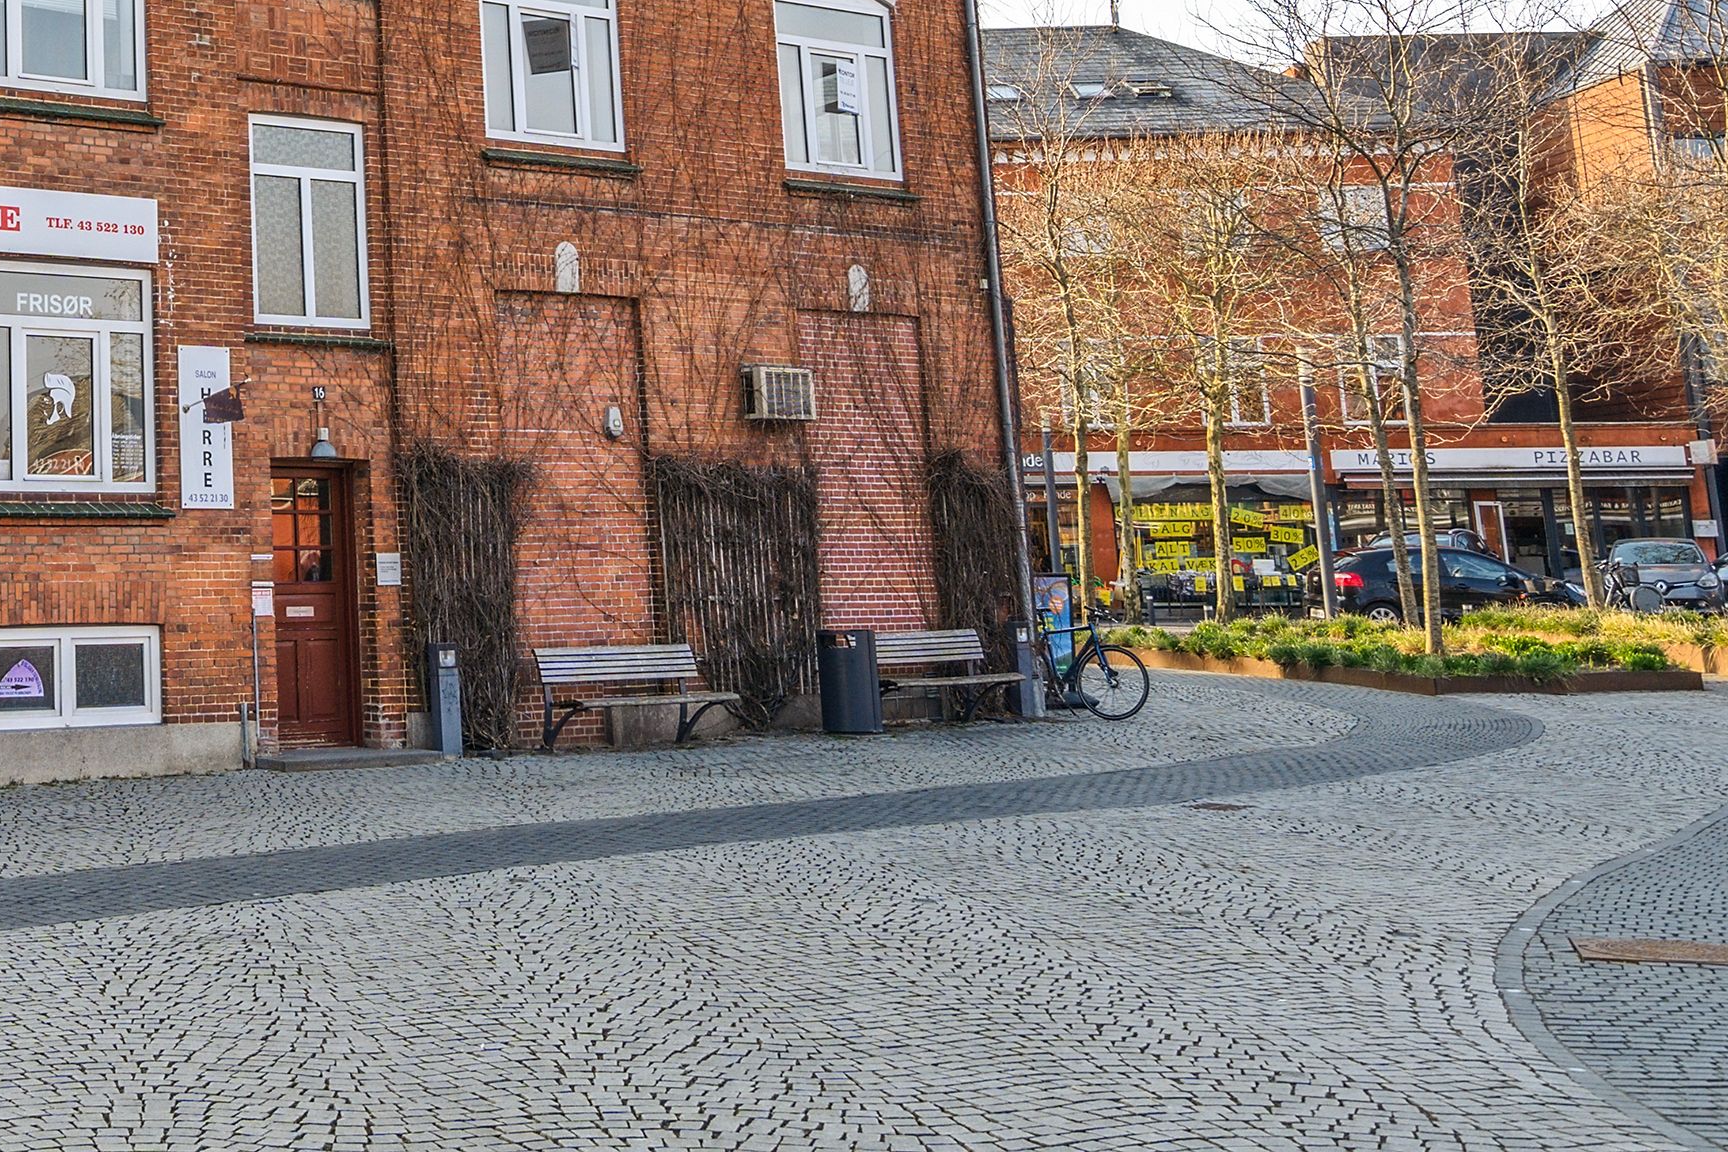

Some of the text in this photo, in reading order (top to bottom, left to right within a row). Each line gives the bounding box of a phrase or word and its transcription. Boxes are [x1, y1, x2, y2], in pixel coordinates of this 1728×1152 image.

[46, 217, 145, 235] TLF. 43 522 130
[16, 292, 93, 316] FRISØR
[195, 369, 217, 379] SALON
[1534, 450, 1642, 464] PIZZABAR
[188, 494, 229, 503] 43 52 21 30
[1233, 511, 1263, 526] 20%
[1151, 523, 1191, 534] SALG
[1272, 529, 1303, 542] 30%
[1157, 543, 1188, 554] ALT
[1234, 538, 1265, 551] 50%
[1291, 548, 1319, 568] 25%
